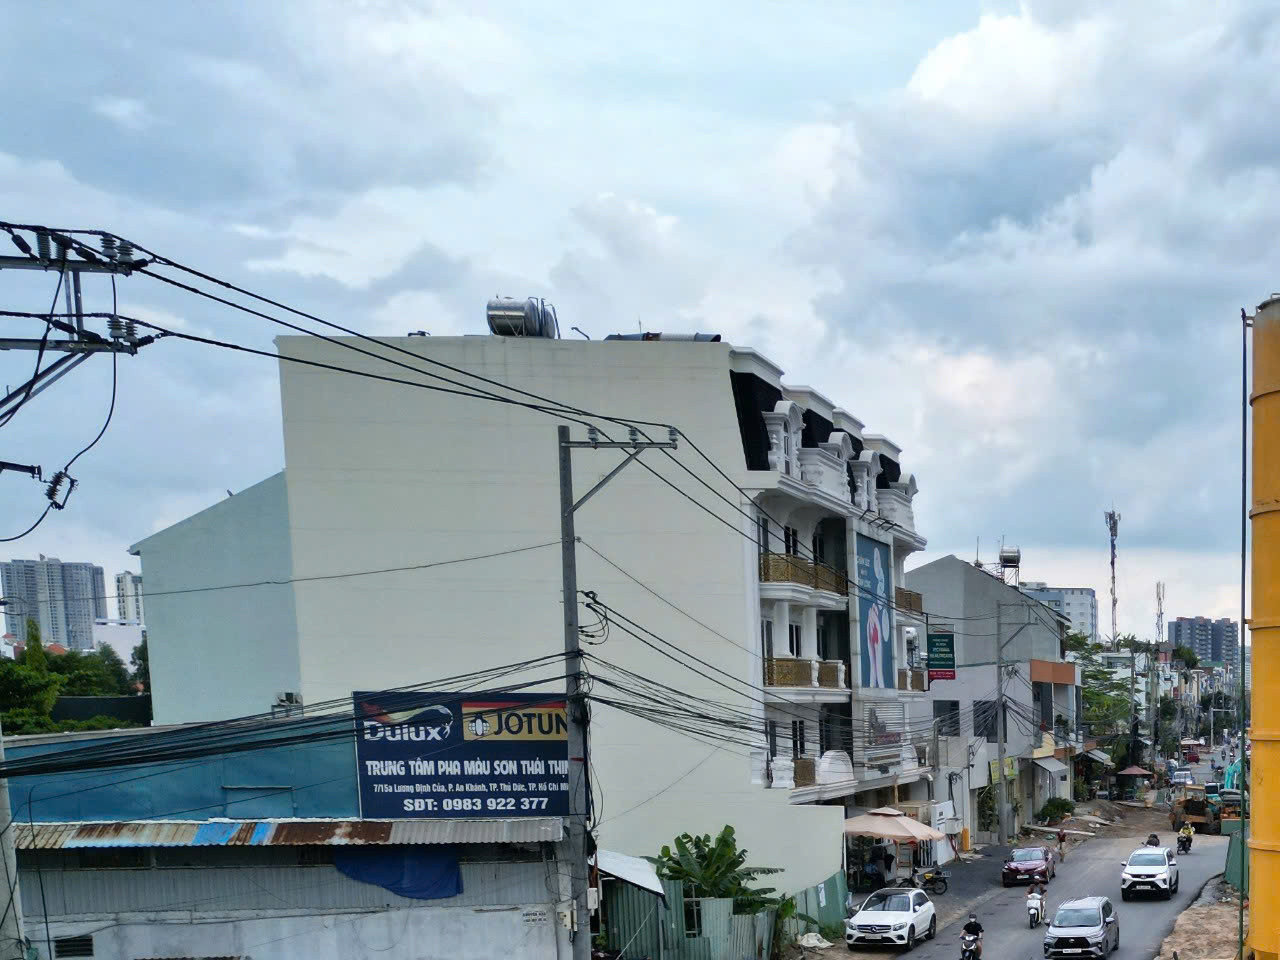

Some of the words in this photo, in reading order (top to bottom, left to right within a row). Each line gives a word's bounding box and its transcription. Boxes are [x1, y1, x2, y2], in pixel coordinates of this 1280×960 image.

[363, 720, 443, 741] Dulux
[494, 711, 568, 735] JOTUN
[366, 760, 406, 776] TRUNG
[408, 757, 435, 776] TÂM
[437, 760, 461, 776] PHA
[463, 757, 491, 776] MÀU
[493, 758, 518, 776] SƠN
[520, 757, 545, 775] THÁI
[455, 783, 465, 792] An
[489, 783, 499, 792] TP.
[527, 782, 538, 792] TP.
[548, 782, 559, 791] Chí
[403, 798, 438, 812] SĐT:
[442, 798, 482, 811] 0983
[486, 798, 516, 810] 922
[520, 797, 549, 811] 377
